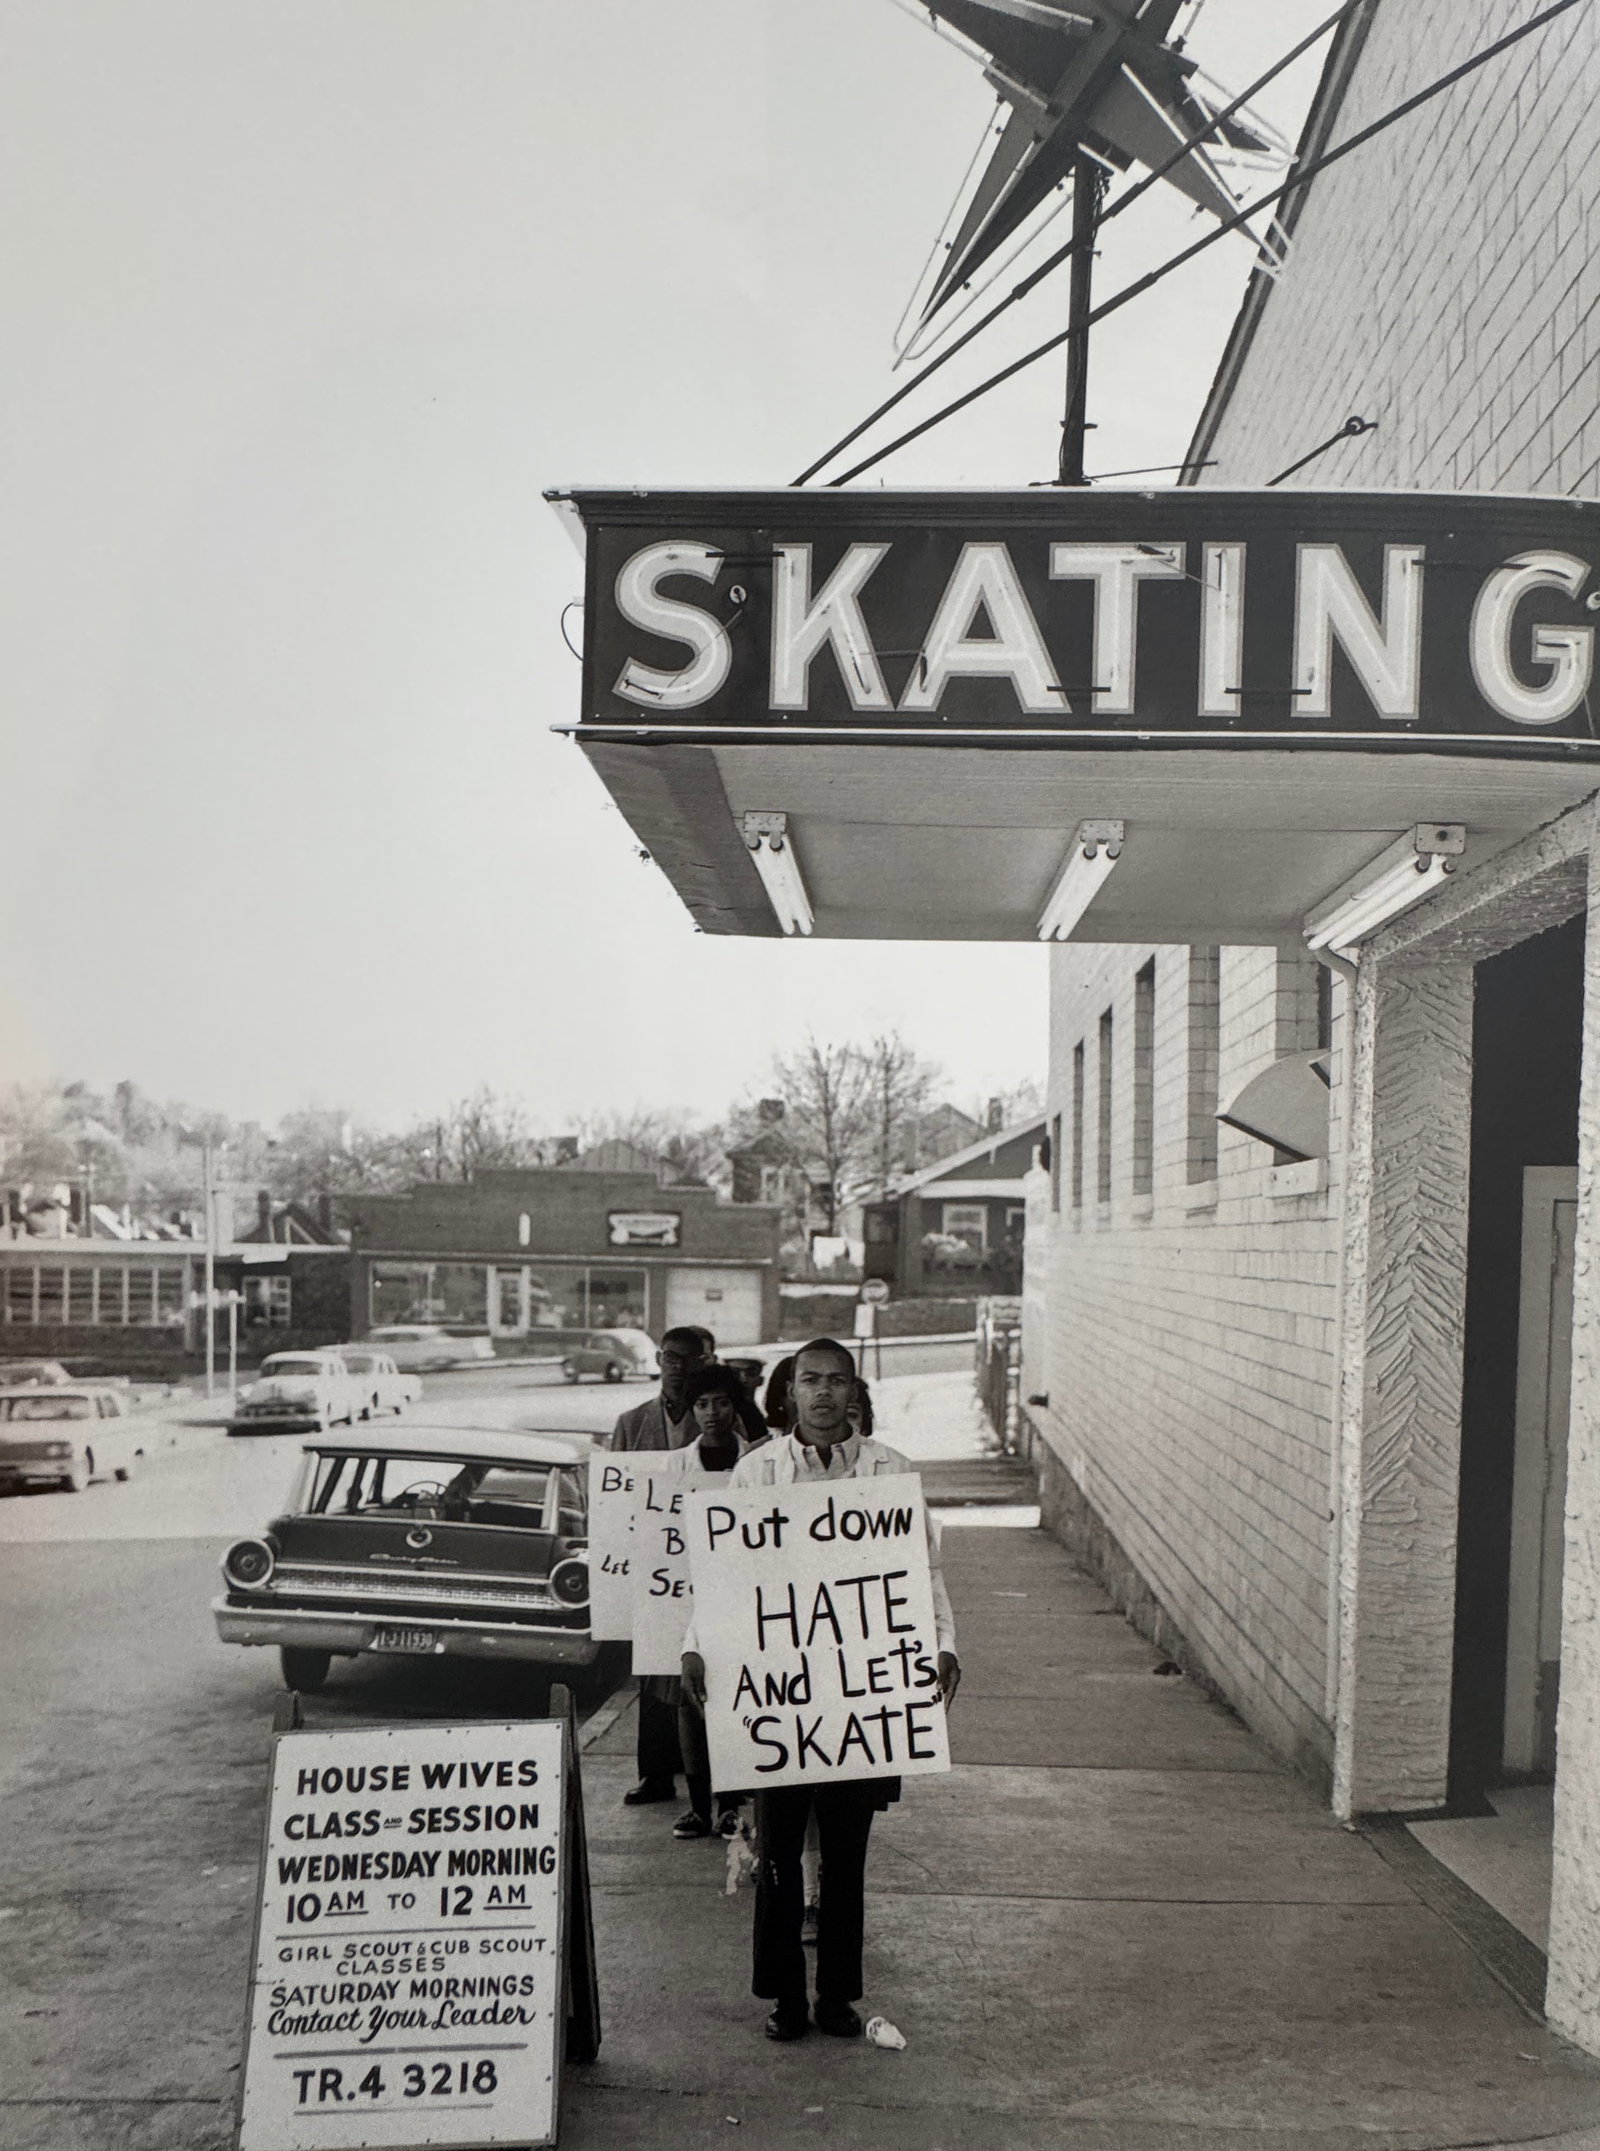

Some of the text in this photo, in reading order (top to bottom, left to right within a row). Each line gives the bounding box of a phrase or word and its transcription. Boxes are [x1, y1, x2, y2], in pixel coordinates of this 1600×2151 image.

[612, 540, 1595, 725] SKATING
[706, 1506, 790, 1551] Put
[756, 1570, 916, 1651] HATE
[297, 1760, 538, 1796] HOUSE WIVES
[284, 1810, 381, 1840] CLASS
[408, 1804, 539, 1834] SESSION
[278, 1846, 556, 1884] WEDNESDAY MORNING
[387, 1893, 416, 1910] TO
[441, 1885, 474, 1917] 12
[487, 1884, 526, 1904] AM
[278, 1946, 332, 1962] GIRL
[343, 1942, 413, 1959] SCOUT
[431, 1940, 470, 1954] CUB
[479, 1938, 547, 1954] SCOUT
[336, 1956, 446, 1976] CLASSES
[269, 1975, 535, 2008] SATURDAY MORNINGS
[267, 2007, 364, 2035] Contact
[431, 2000, 537, 2030] Leader
[402, 2059, 498, 2097] 3218
